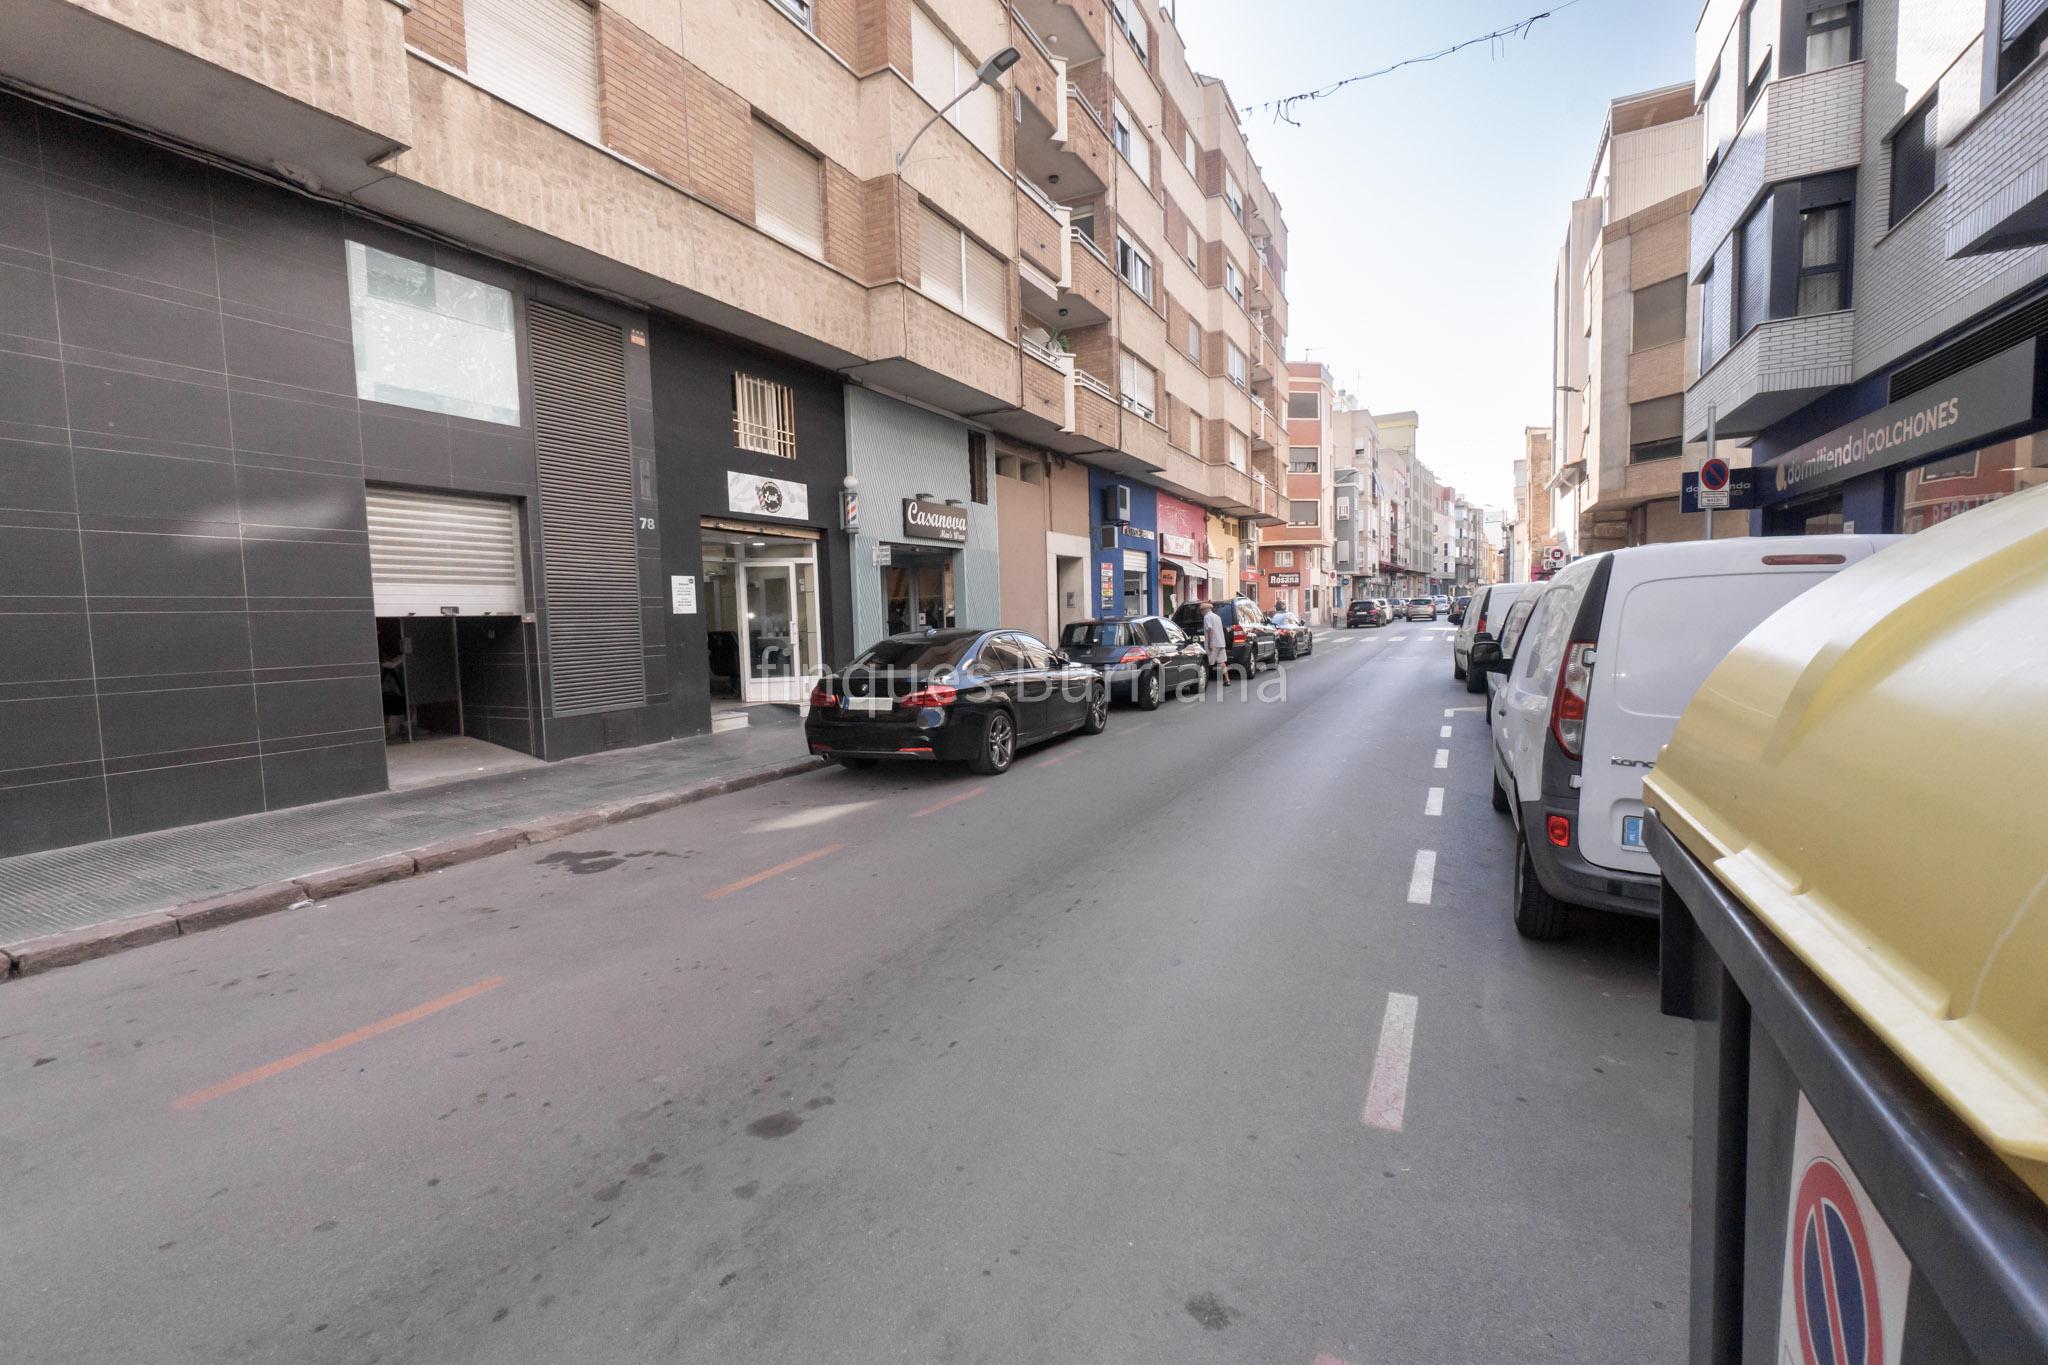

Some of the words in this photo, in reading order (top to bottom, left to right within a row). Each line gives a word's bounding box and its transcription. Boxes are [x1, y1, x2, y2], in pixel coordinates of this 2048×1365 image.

[1787, 435, 1862, 485] dormitienda
[1866, 397, 1959, 455] COLCHONES
[639, 517, 656, 530] 78
[907, 501, 967, 531] Casanova
[1270, 575, 1300, 584] Rosana
